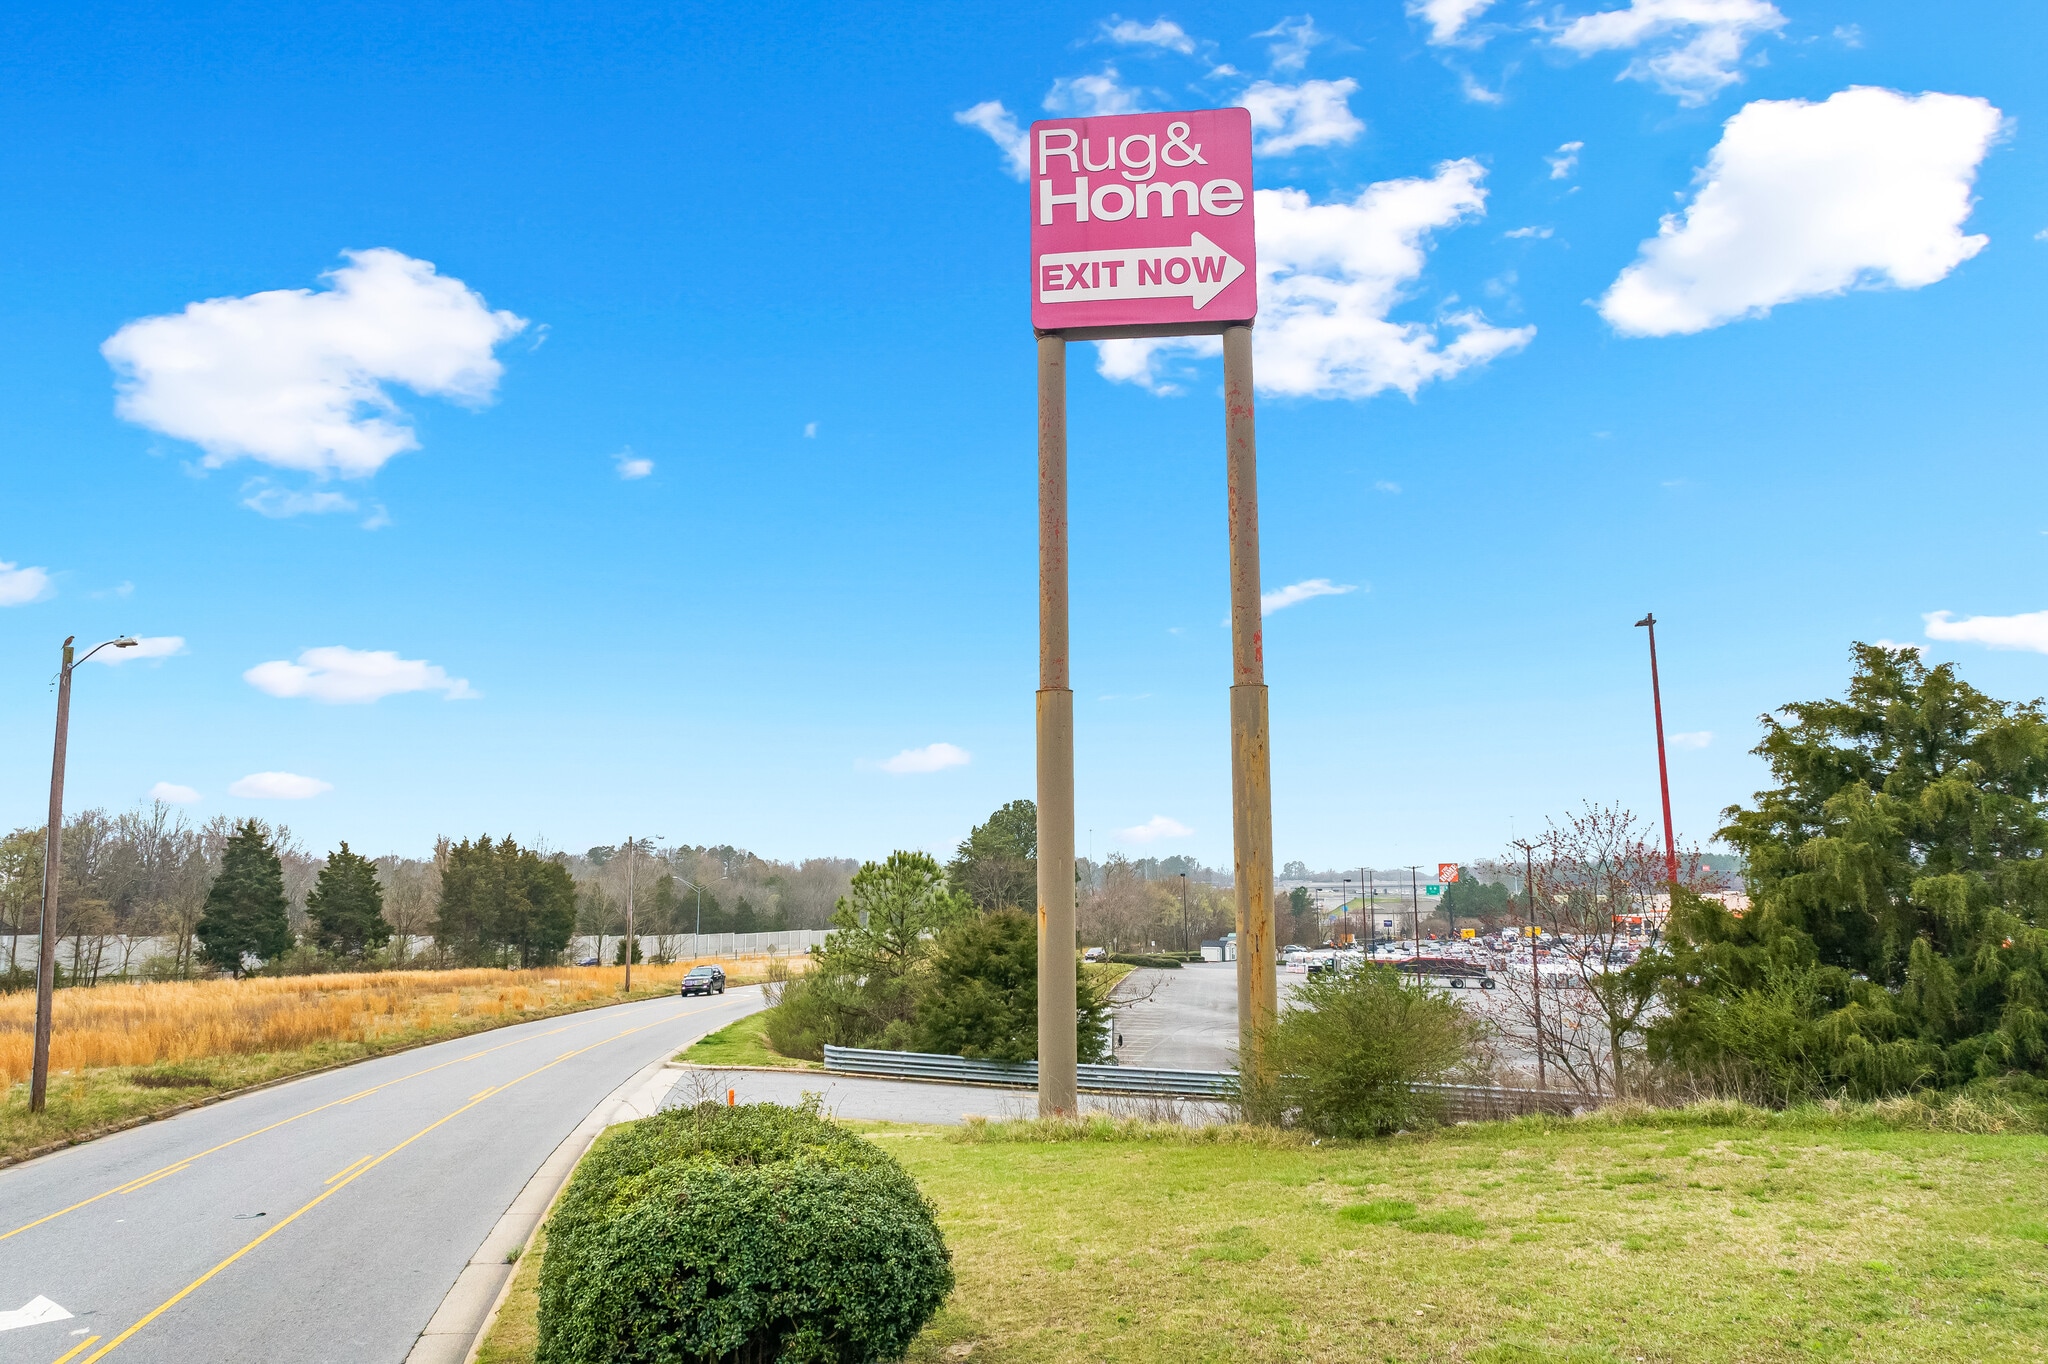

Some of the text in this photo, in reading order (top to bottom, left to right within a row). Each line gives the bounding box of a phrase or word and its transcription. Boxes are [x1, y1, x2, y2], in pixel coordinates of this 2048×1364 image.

[1040, 177, 1243, 225] Home
[1042, 256, 1227, 291] EXIT NOW
